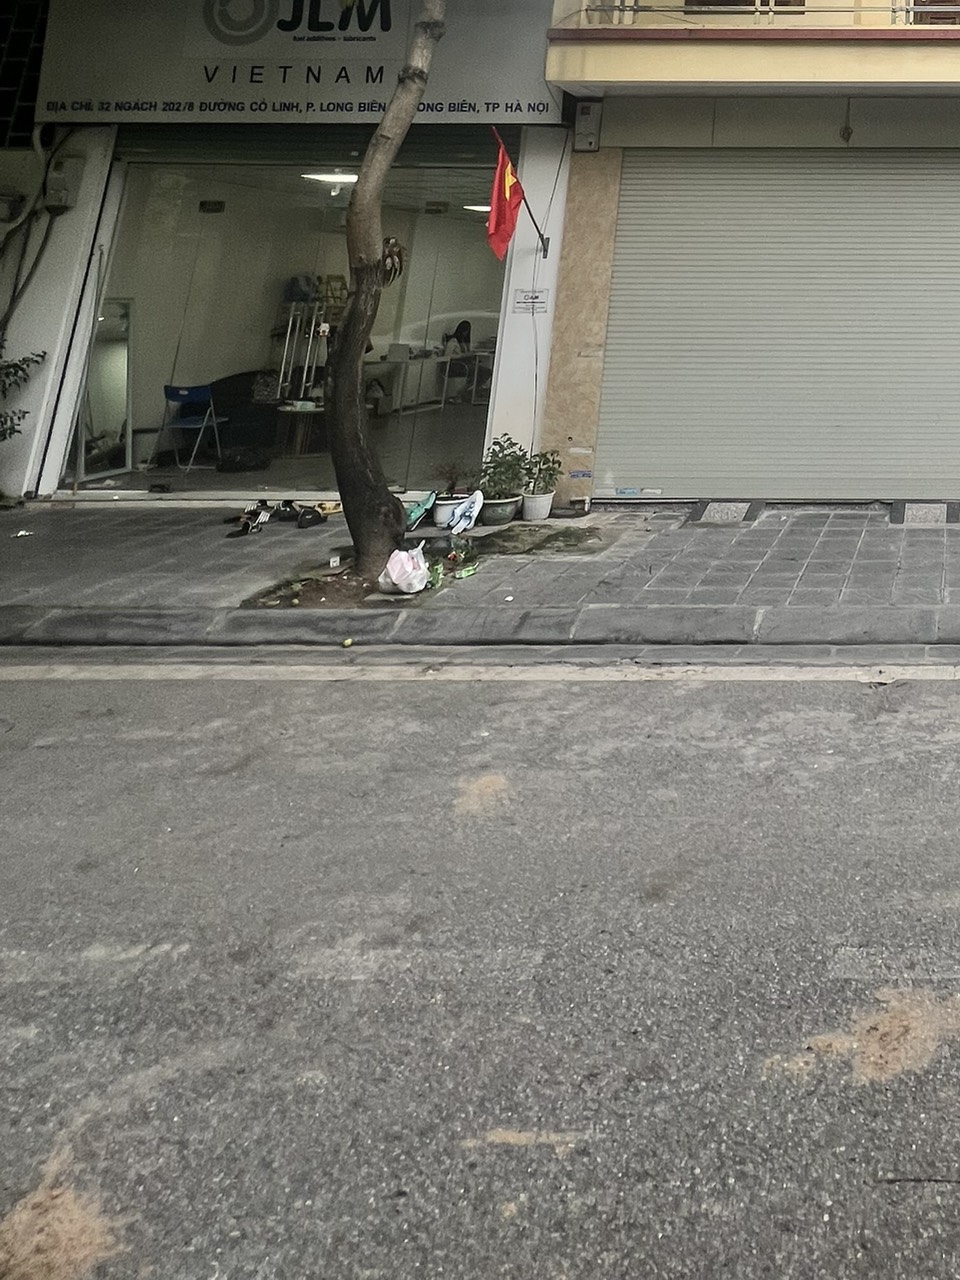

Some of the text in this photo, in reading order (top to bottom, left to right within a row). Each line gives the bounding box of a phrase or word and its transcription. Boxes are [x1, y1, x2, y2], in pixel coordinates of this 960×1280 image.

[204, 65, 385, 84] VIETNAM
[98, 101, 111, 112] 32
[271, 101, 302, 114] LINH,
[306, 102, 316, 113] P.
[320, 102, 354, 112] LONG
[416, 102, 445, 113] ONG
[448, 99, 481, 114] BIÊN,
[484, 102, 500, 113] TP
[504, 99, 524, 113] HÀ
